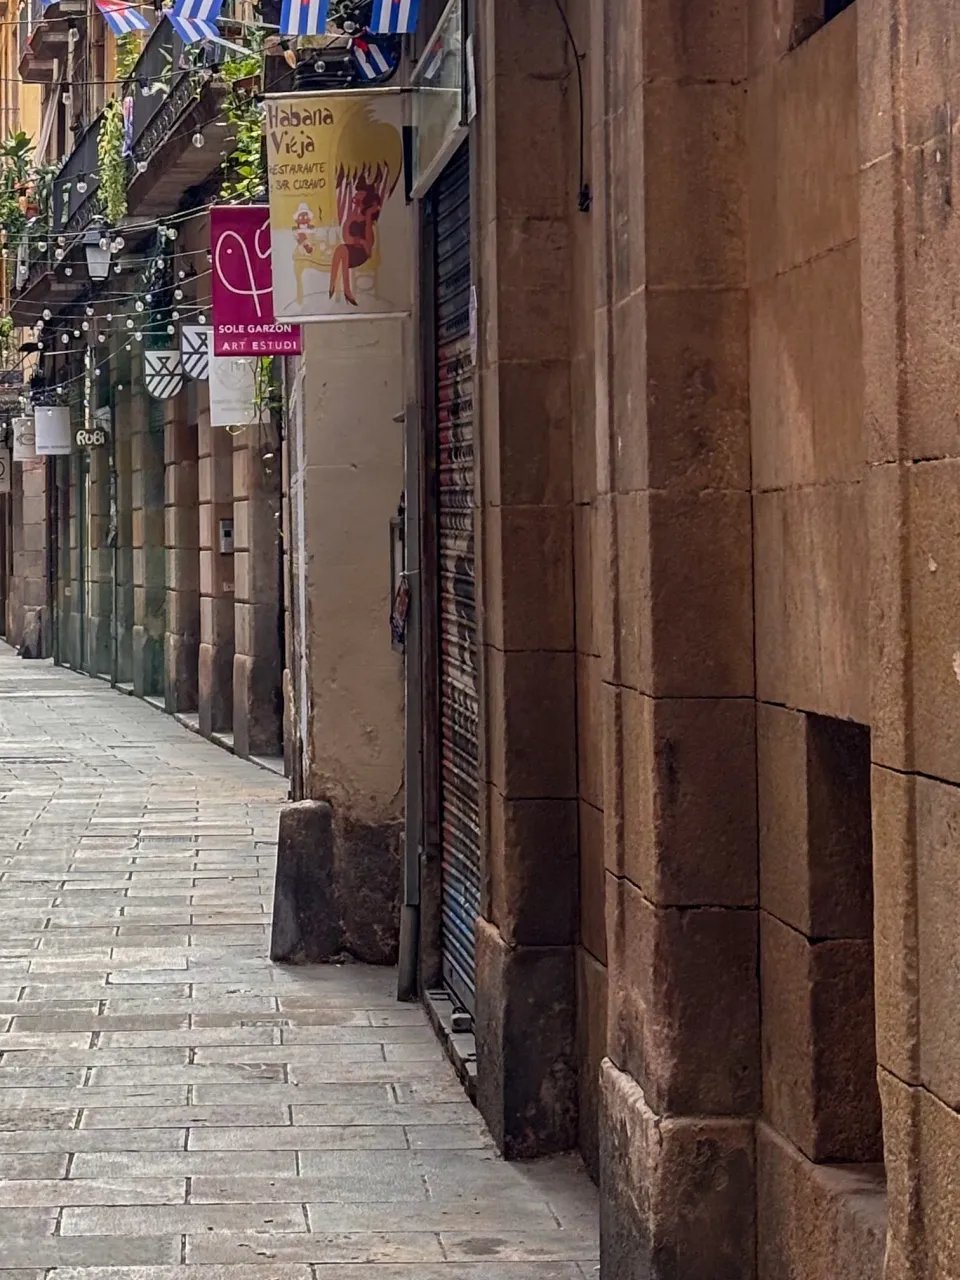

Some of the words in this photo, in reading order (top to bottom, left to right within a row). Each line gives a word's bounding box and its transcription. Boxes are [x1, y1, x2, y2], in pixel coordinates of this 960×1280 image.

[268, 104, 333, 129] Habana
[275, 179, 290, 190] BAR
[293, 178, 326, 190] CUBANO
[218, 324, 245, 333] SOLE
[222, 341, 246, 350] ART
[252, 341, 297, 350] ESTUDI
